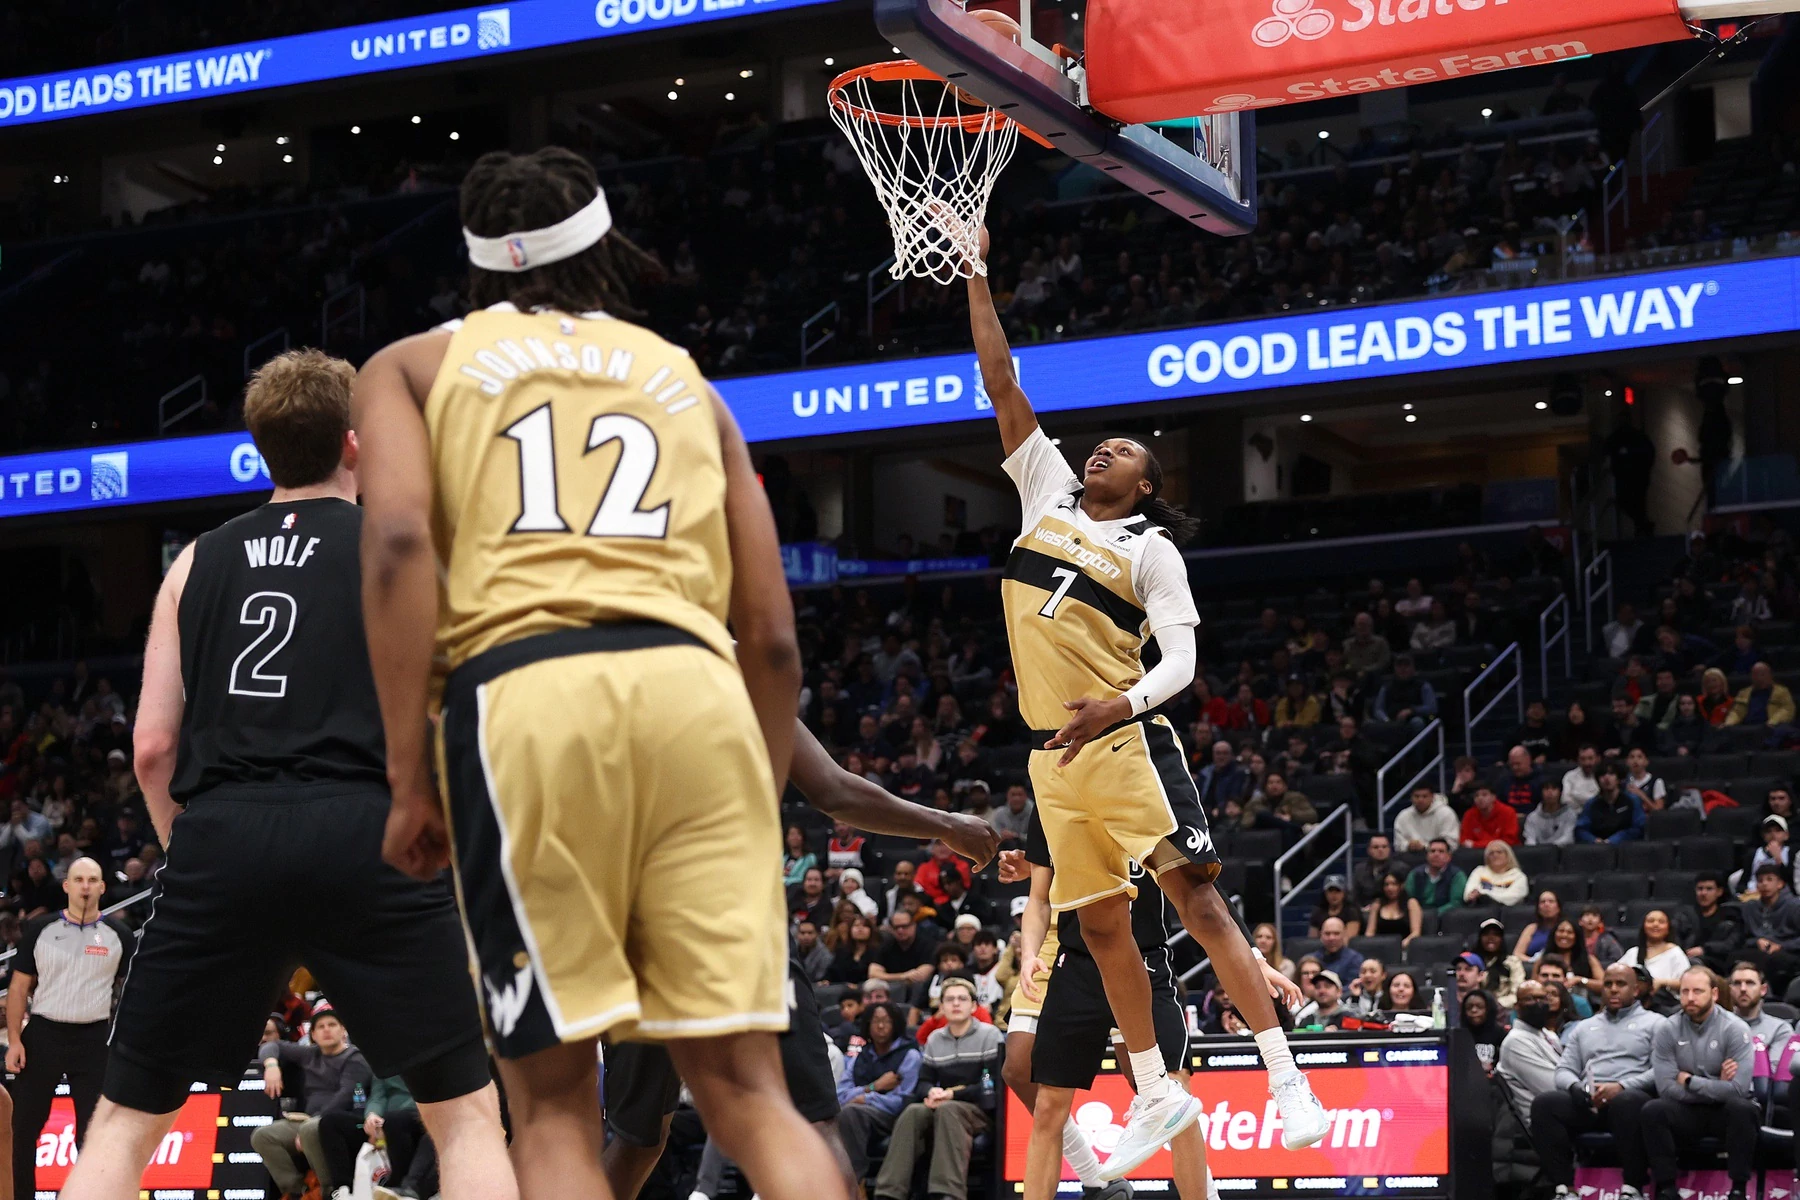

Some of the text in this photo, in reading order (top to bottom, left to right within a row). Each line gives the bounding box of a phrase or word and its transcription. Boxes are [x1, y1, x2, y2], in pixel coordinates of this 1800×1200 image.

[351, 23, 471, 60] UNITED
[42, 70, 133, 112] LEADS
[136, 62, 192, 97] THE
[1147, 331, 1297, 388] GOOD
[1307, 312, 1467, 371] LEADS
[1474, 299, 1572, 351] THE
[459, 336, 698, 414] JOHNSON III
[792, 374, 964, 417] UNITED
[498, 401, 671, 539] 12
[244, 535, 321, 568] WOLF
[1034, 527, 1122, 579] washington
[1038, 566, 1079, 620] 7
[229, 591, 297, 697] 2
